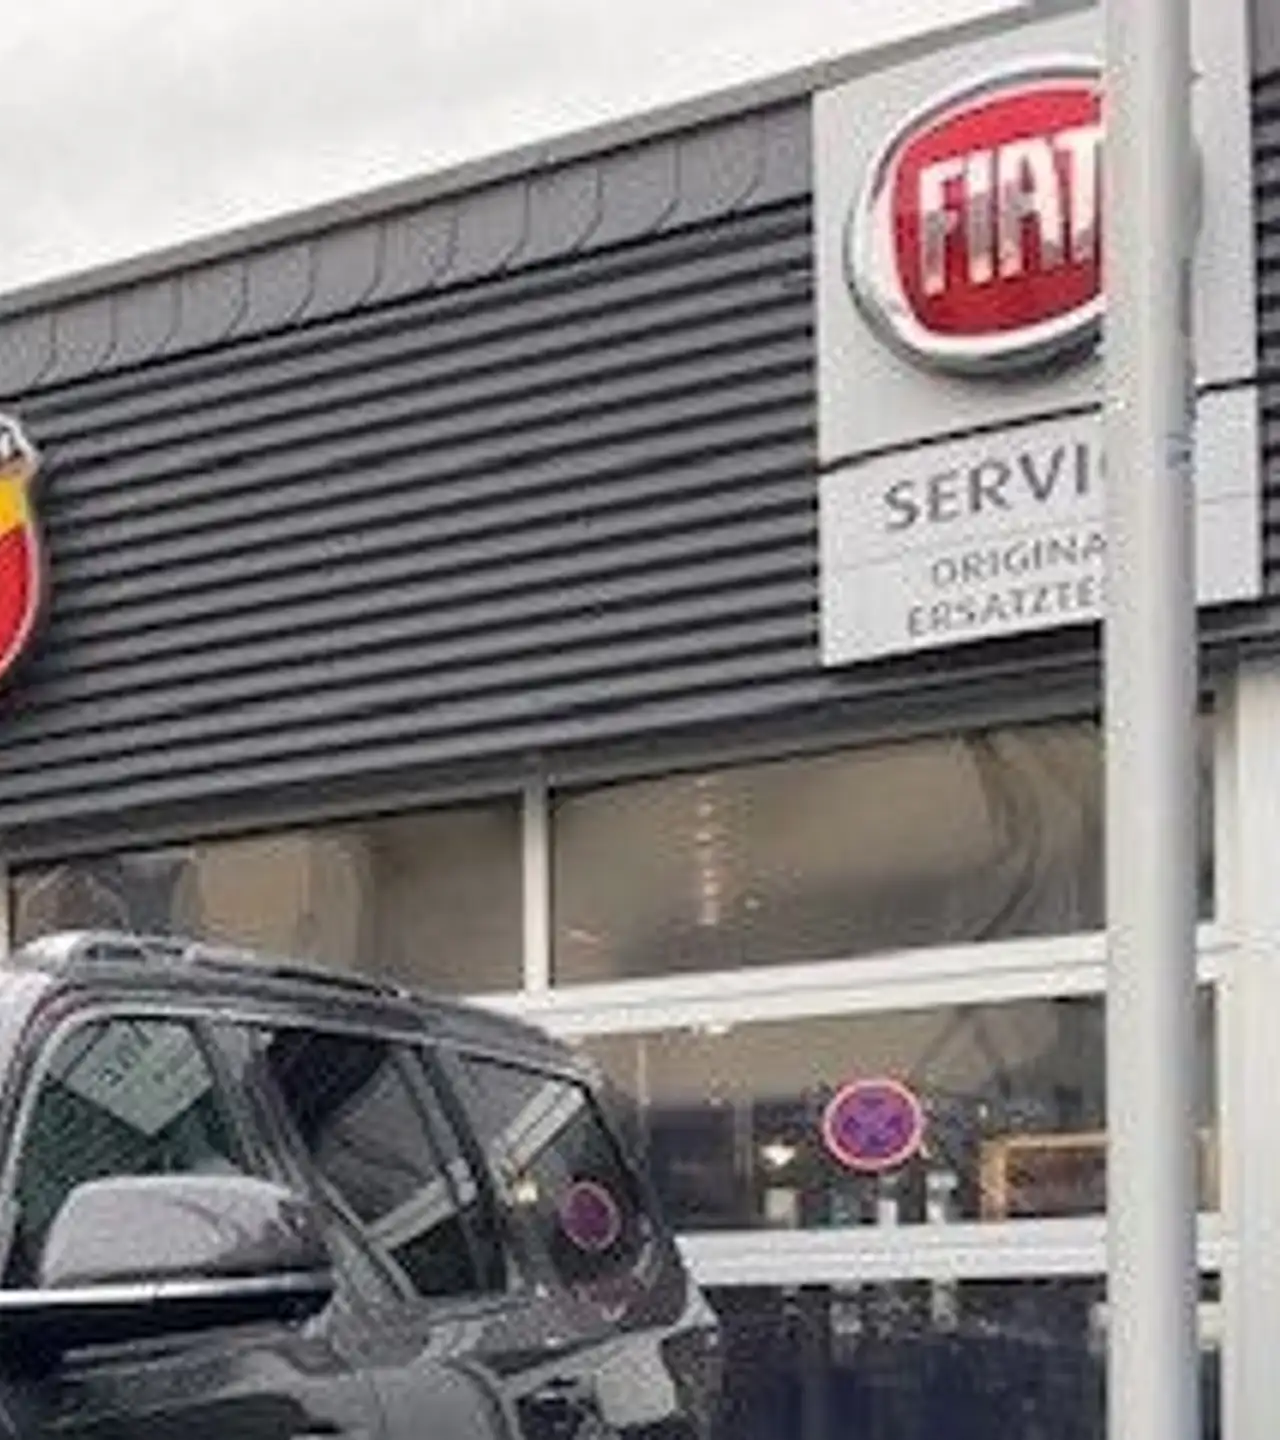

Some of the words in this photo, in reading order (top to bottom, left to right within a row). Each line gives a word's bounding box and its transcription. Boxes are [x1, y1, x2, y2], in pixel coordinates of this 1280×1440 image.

[919, 125, 1104, 300] FIAT
[883, 442, 1108, 533] SERVI
[931, 532, 1108, 589] ORIGINA
[905, 575, 1100, 639] ERSATZTE
